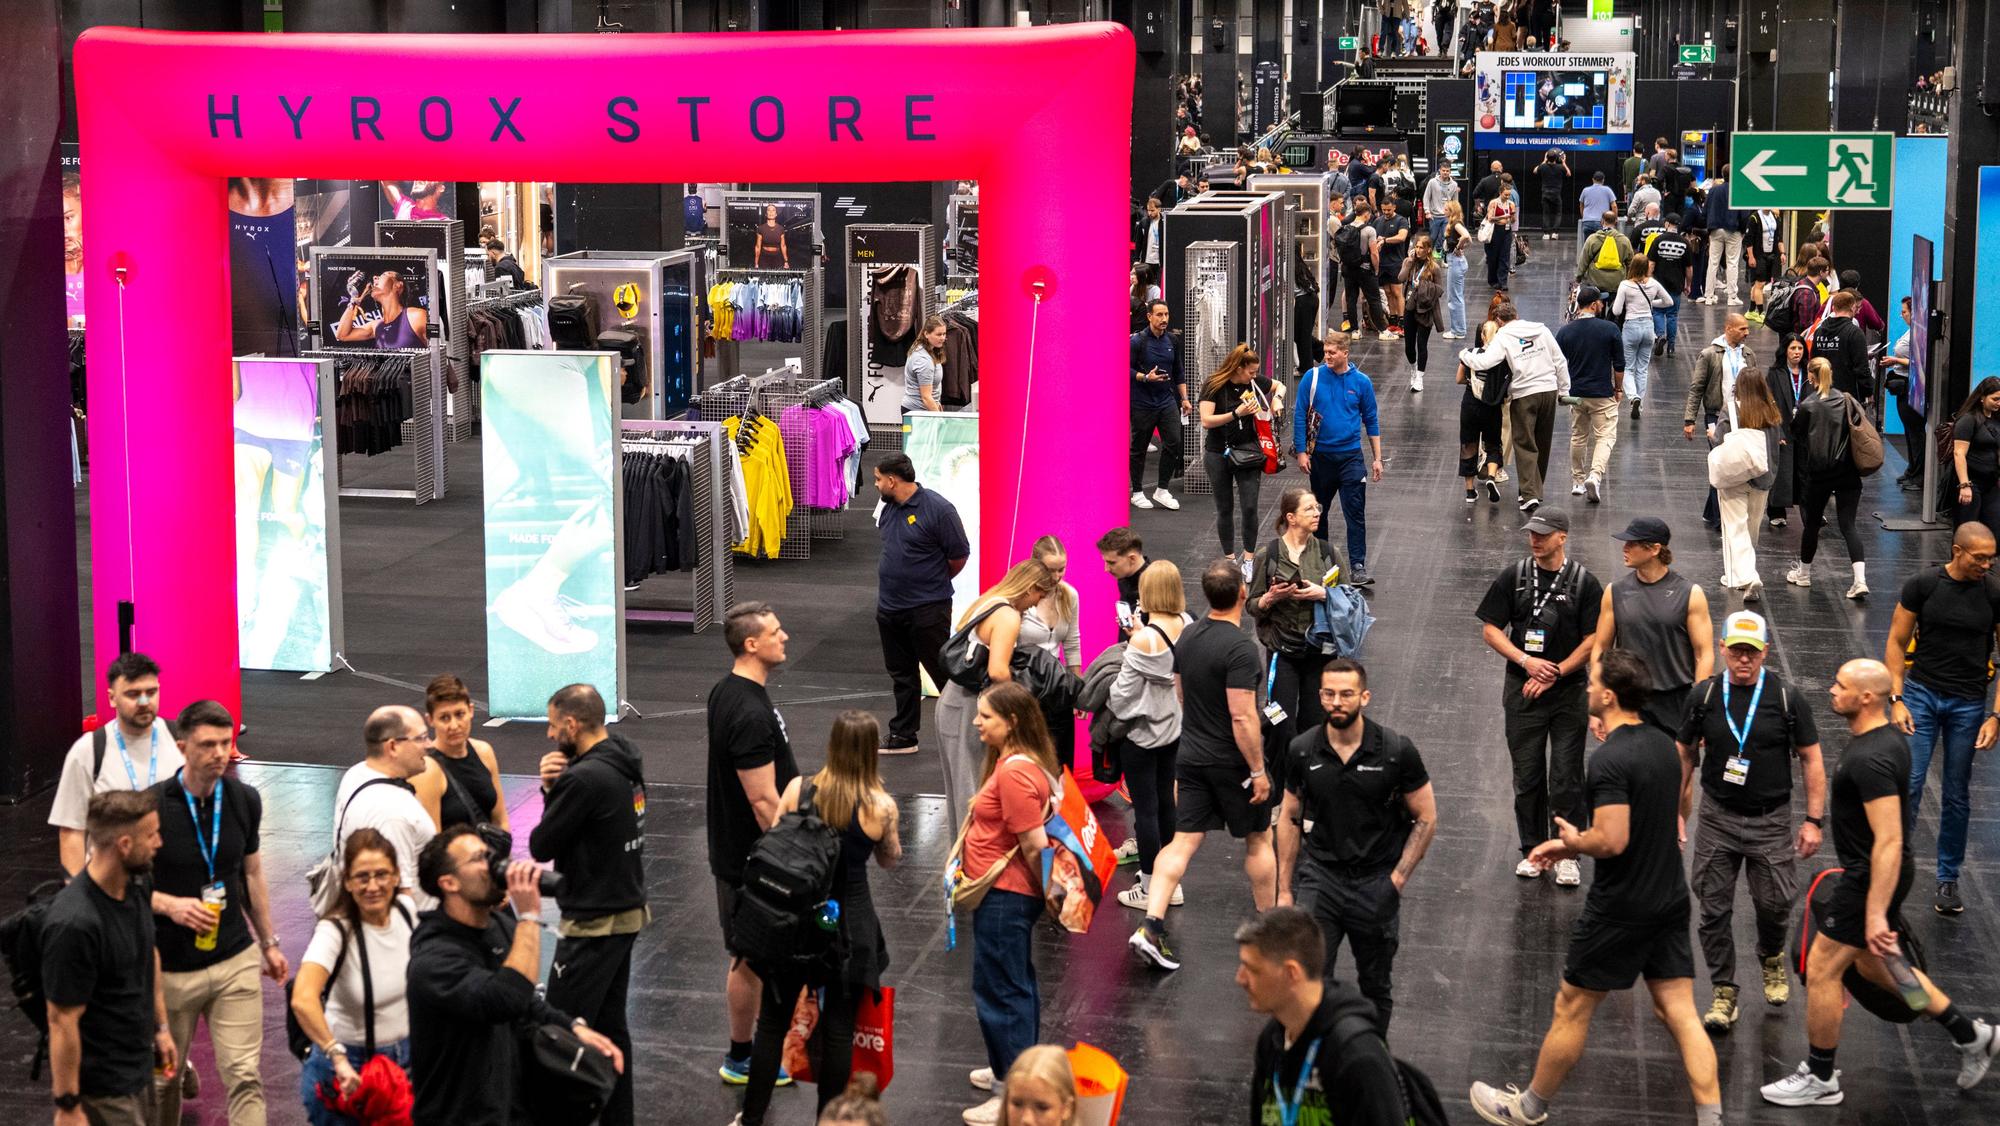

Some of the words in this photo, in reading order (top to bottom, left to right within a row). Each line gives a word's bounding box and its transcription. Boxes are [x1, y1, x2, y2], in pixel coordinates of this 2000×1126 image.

[1147, 12, 1153, 20] G
[1761, 11, 1767, 20] F
[1146, 26, 1154, 34] 14
[1760, 25, 1768, 34] 14
[1496, 57, 1520, 67] JEDES
[1522, 56, 1566, 67] WORKOUT
[1568, 56, 1615, 66] STEMMEN?
[207, 94, 526, 142] HYROX
[606, 94, 937, 143] STORE
[1505, 137, 1516, 145] RED
[1516, 137, 1528, 145] BULL
[235, 224, 270, 232] HYROX
[857, 250, 875, 258] MEN
